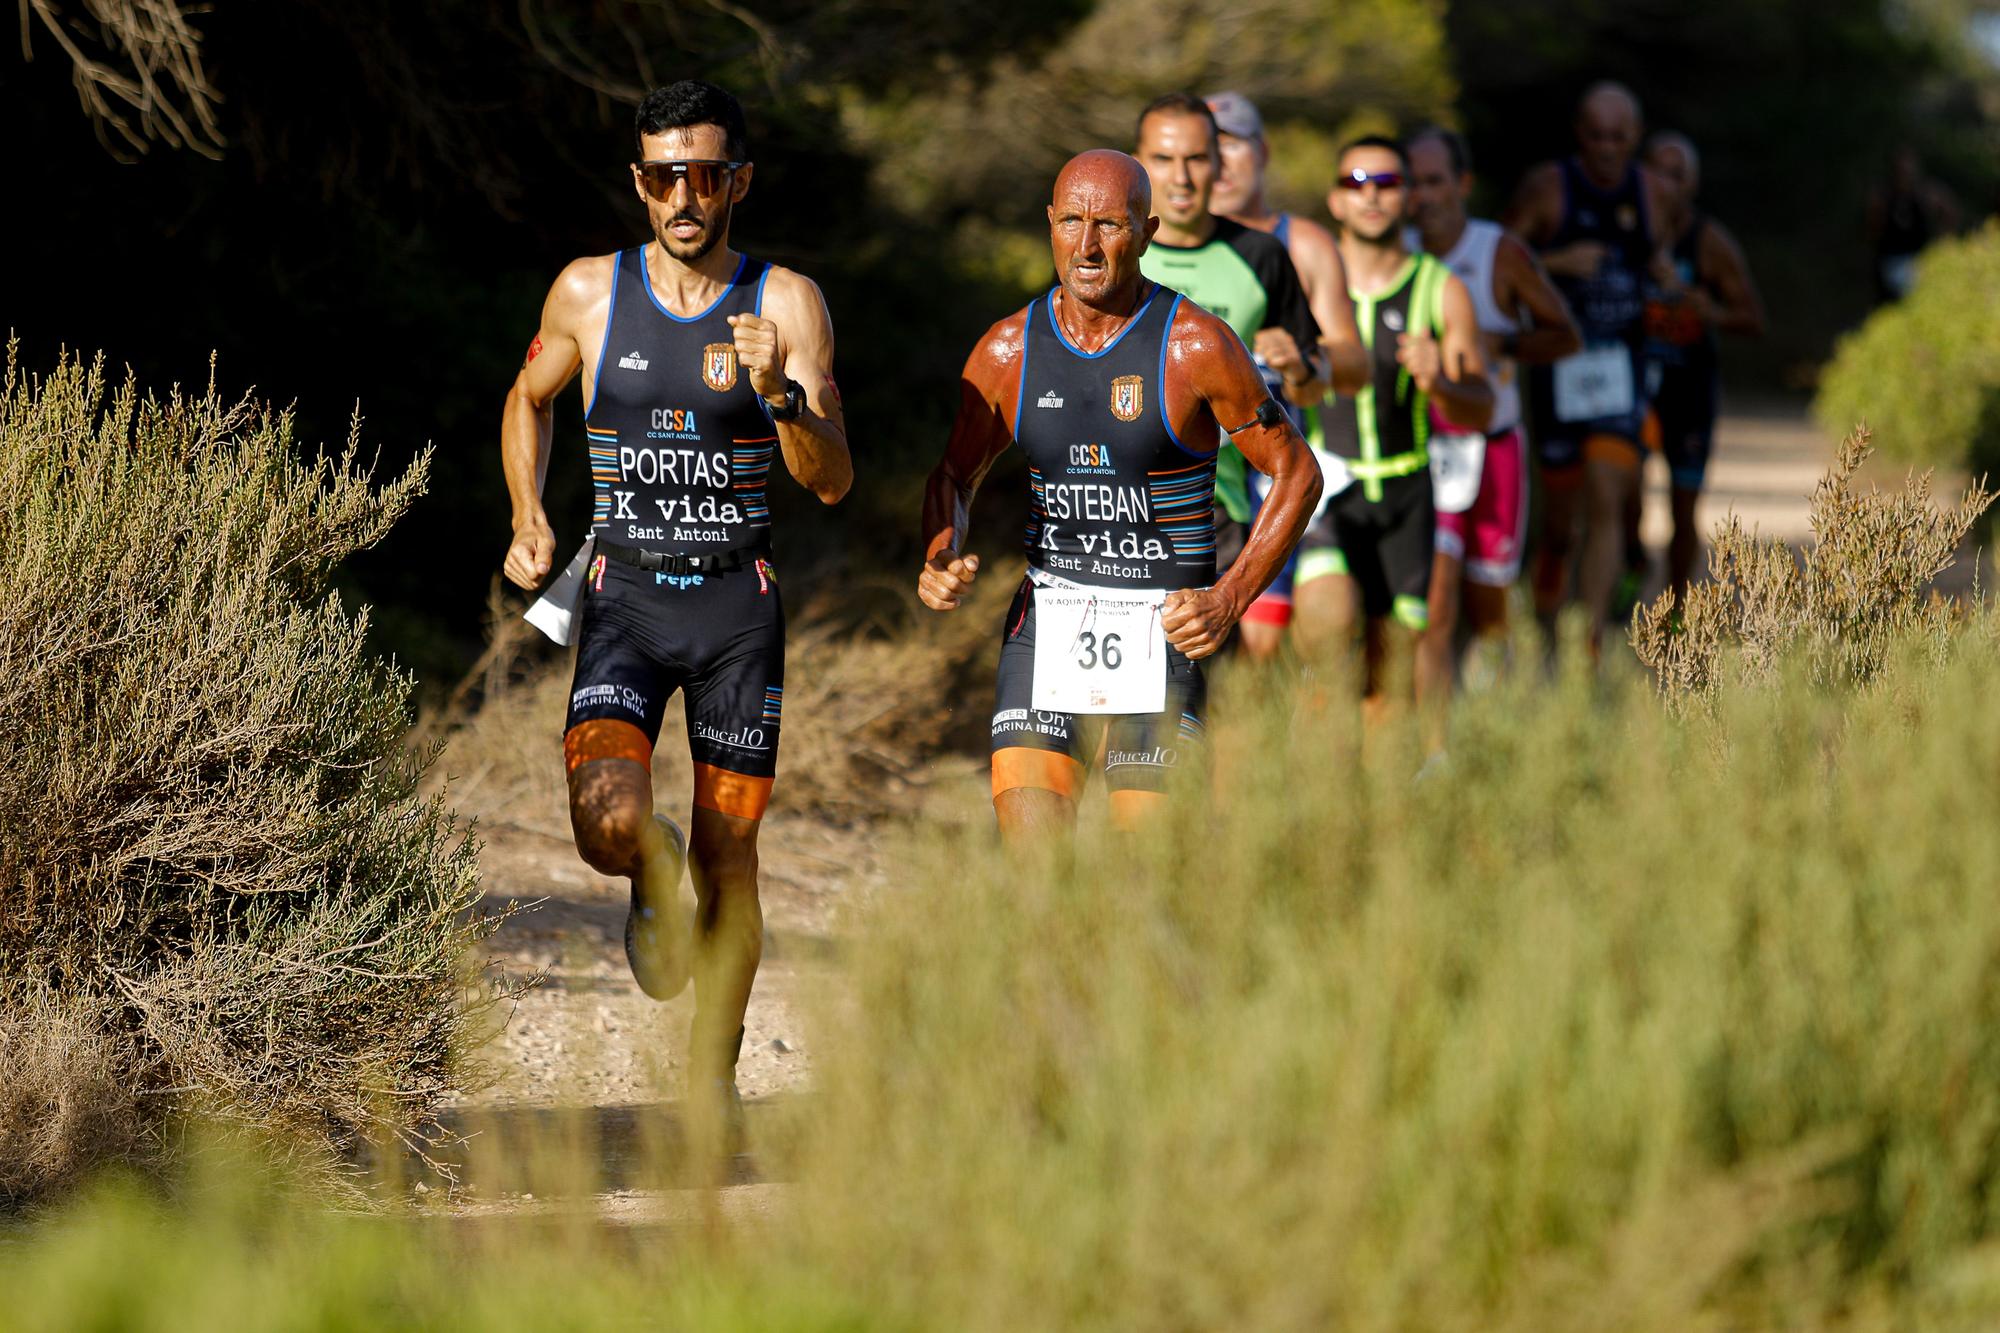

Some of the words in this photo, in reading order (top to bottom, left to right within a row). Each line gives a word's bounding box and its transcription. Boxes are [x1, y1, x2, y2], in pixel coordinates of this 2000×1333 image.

[618, 356, 649, 371] HORIZON
[1037, 397, 1064, 409] HORIZON
[651, 408, 696, 432] CCSA
[646, 431, 657, 439] CC
[657, 432, 675, 440] SANT
[675, 433, 701, 441] ANTONI
[1069, 444, 1110, 467] CCSA
[620, 447, 729, 488] PORTAS
[1092, 468, 1116, 476] ANTONI
[613, 490, 638, 520] K
[655, 494, 743, 524] vida
[1045, 483, 1149, 523] ESTEBAN
[627, 525, 664, 540] Sant
[673, 527, 730, 542] Antoni
[1038, 522, 1060, 551] K
[1076, 530, 1169, 561] vida
[1049, 555, 1082, 571] Sant
[1091, 560, 1152, 579] Antoni
[655, 571, 704, 590] Pepe
[1078, 631, 1122, 670] 36
[573, 695, 620, 712] MARINA
[622, 698, 645, 719] IBIZA
[991, 721, 1033, 737] MARINA
[1036, 723, 1068, 739] IBIZA
